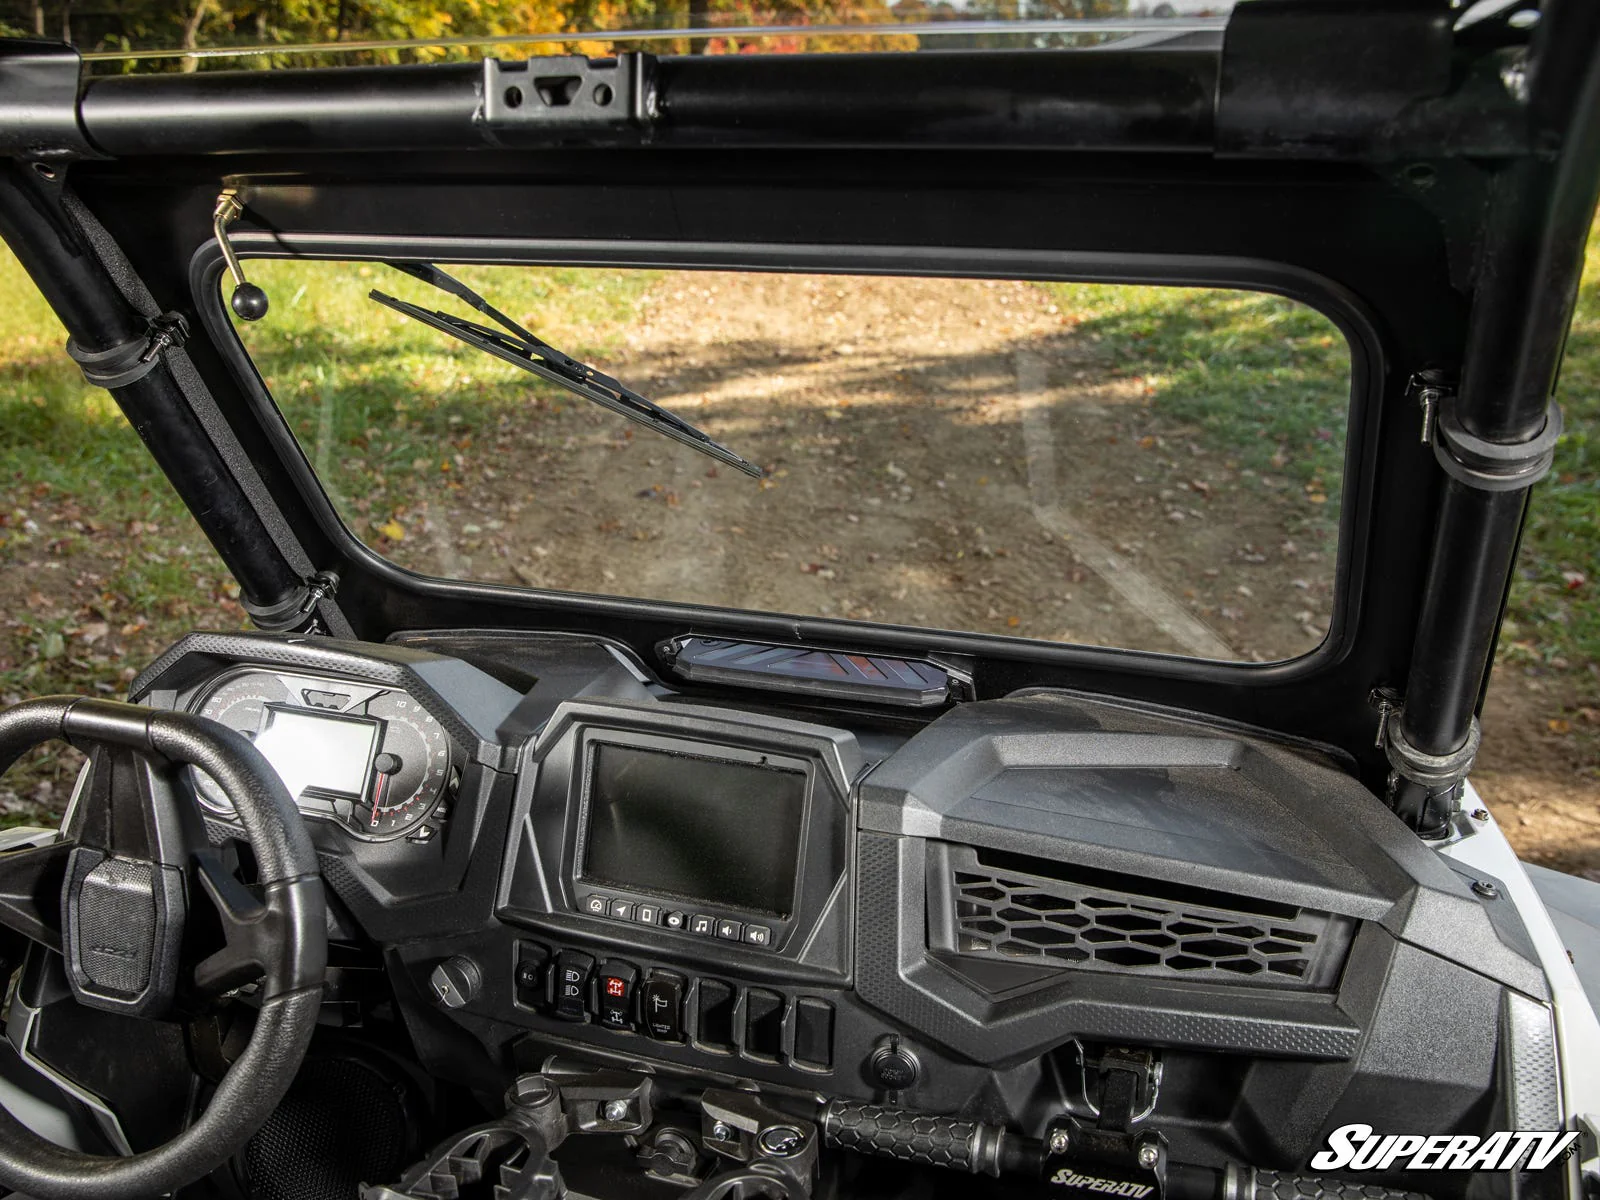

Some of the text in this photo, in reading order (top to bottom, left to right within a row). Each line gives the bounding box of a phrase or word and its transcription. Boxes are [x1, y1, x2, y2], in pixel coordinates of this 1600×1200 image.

[396, 700, 407, 708] 10
[413, 705, 421, 713] 9
[425, 715, 434, 723] 8
[433, 732, 441, 740] 7
[429, 787, 438, 795] 4
[418, 802, 426, 810] 3
[404, 813, 413, 821] 2
